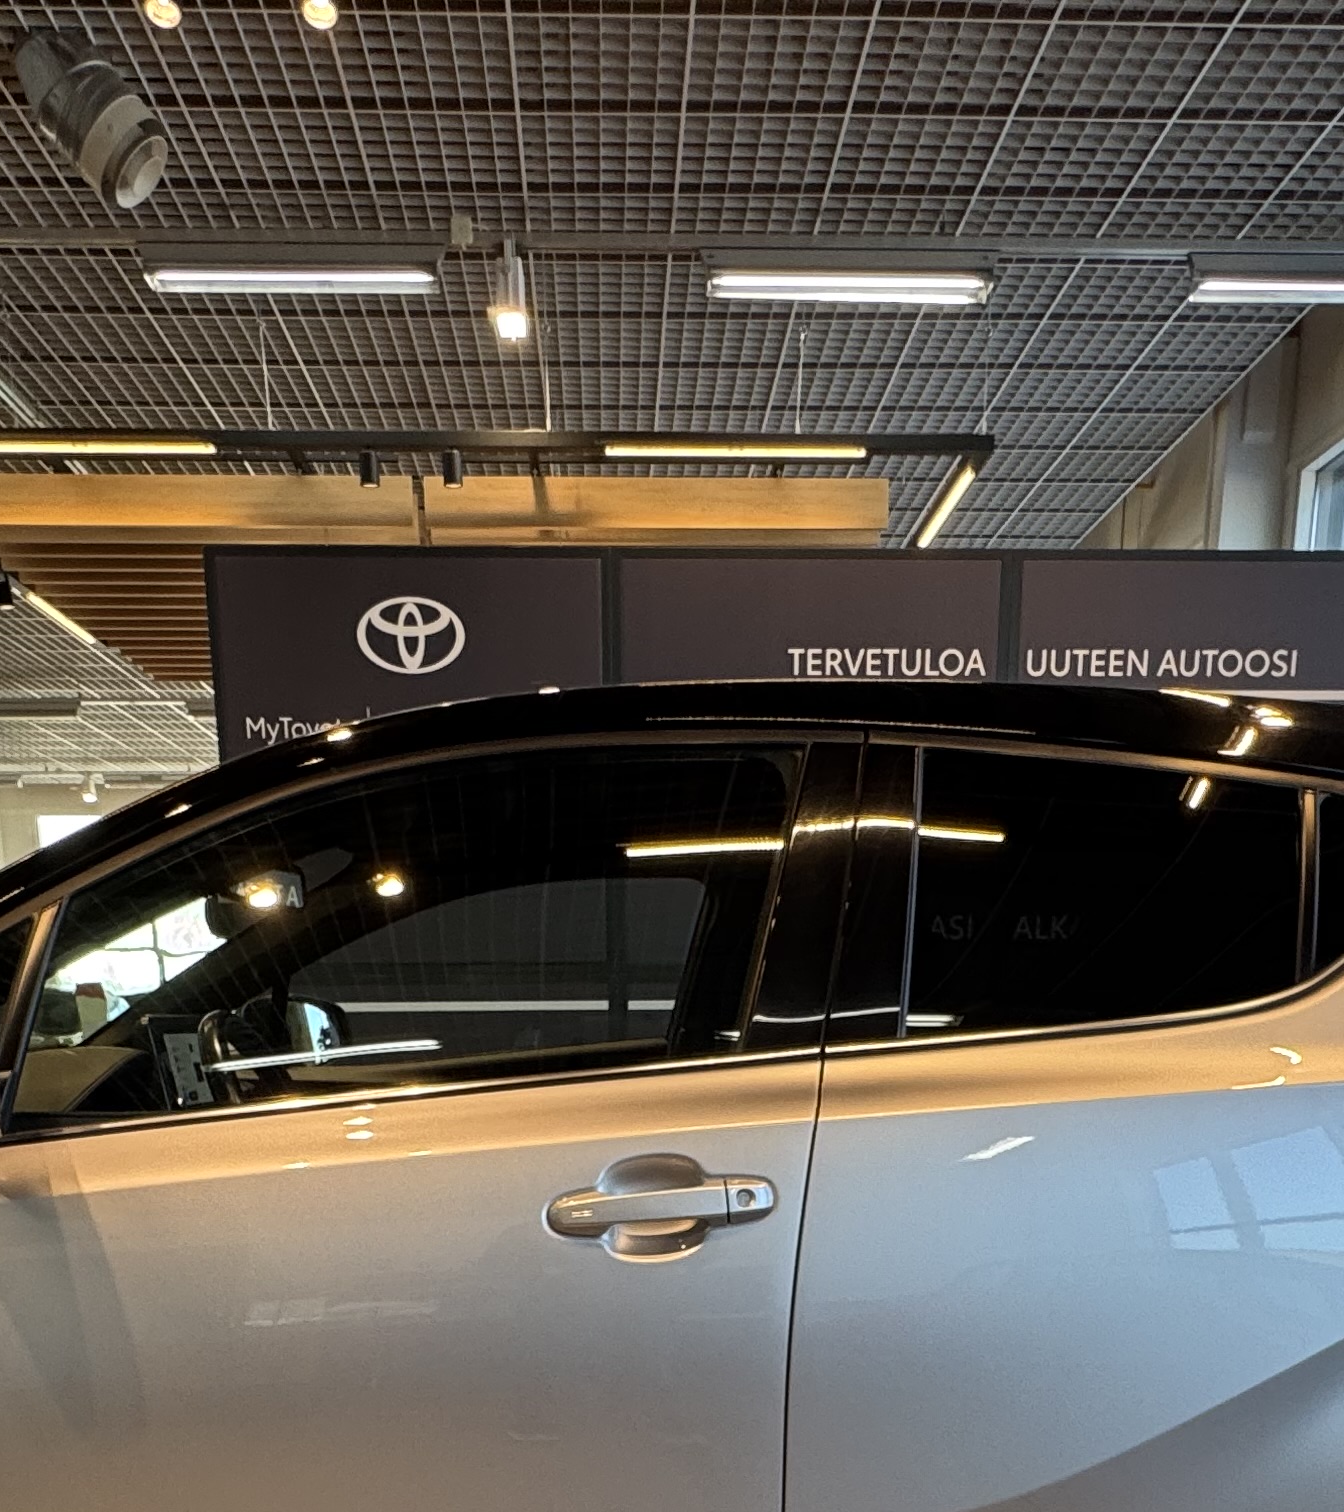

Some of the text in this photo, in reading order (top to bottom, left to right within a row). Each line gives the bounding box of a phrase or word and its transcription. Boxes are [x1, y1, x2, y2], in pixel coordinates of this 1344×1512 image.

[787, 648, 1297, 677] TERVETULOA UUTEEN AUTOOSI
